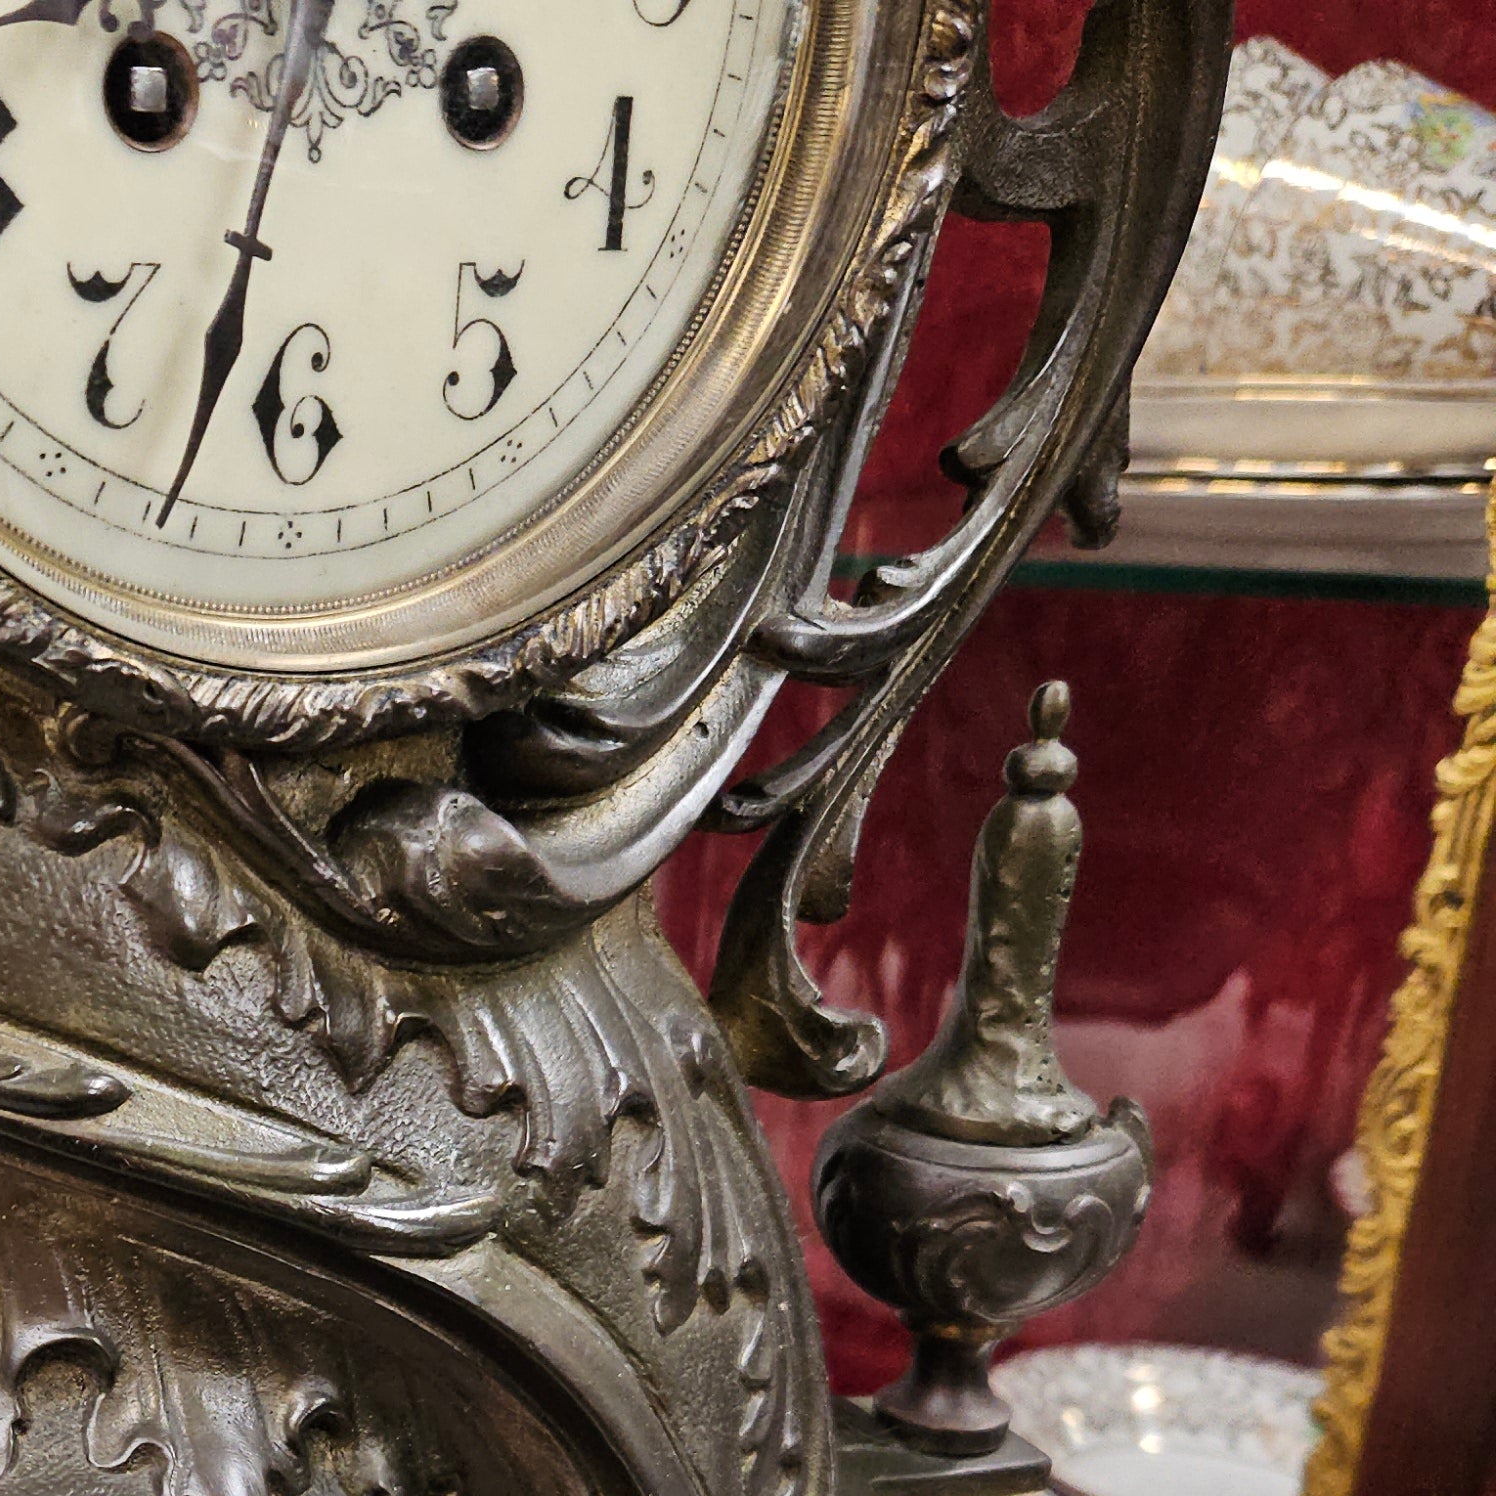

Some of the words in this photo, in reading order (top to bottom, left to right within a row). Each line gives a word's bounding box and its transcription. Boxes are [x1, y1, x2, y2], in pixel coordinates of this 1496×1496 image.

[563, 95, 656, 252] 4
[66, 261, 162, 430] 7
[251, 322, 344, 486] 6
[442, 259, 526, 421] 5
